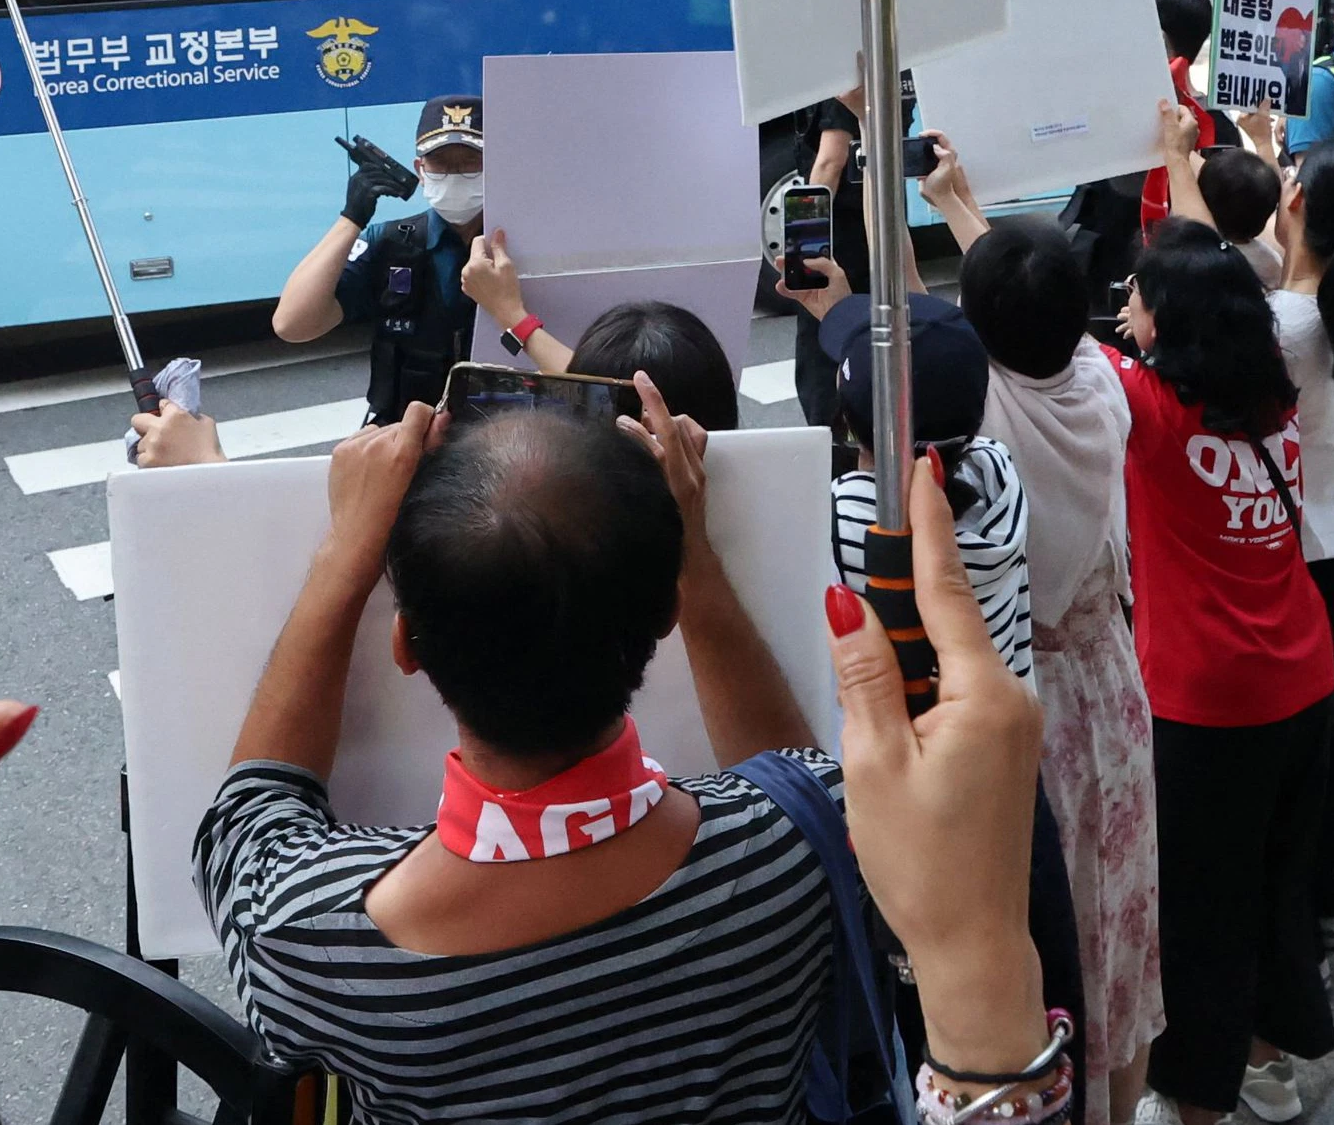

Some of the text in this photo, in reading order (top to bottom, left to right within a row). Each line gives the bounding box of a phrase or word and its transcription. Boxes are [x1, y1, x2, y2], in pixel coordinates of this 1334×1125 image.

[32, 26, 279, 76] 법무부 교정본부
[93, 67, 209, 94] Correctional
[213, 63, 281, 83] Service
